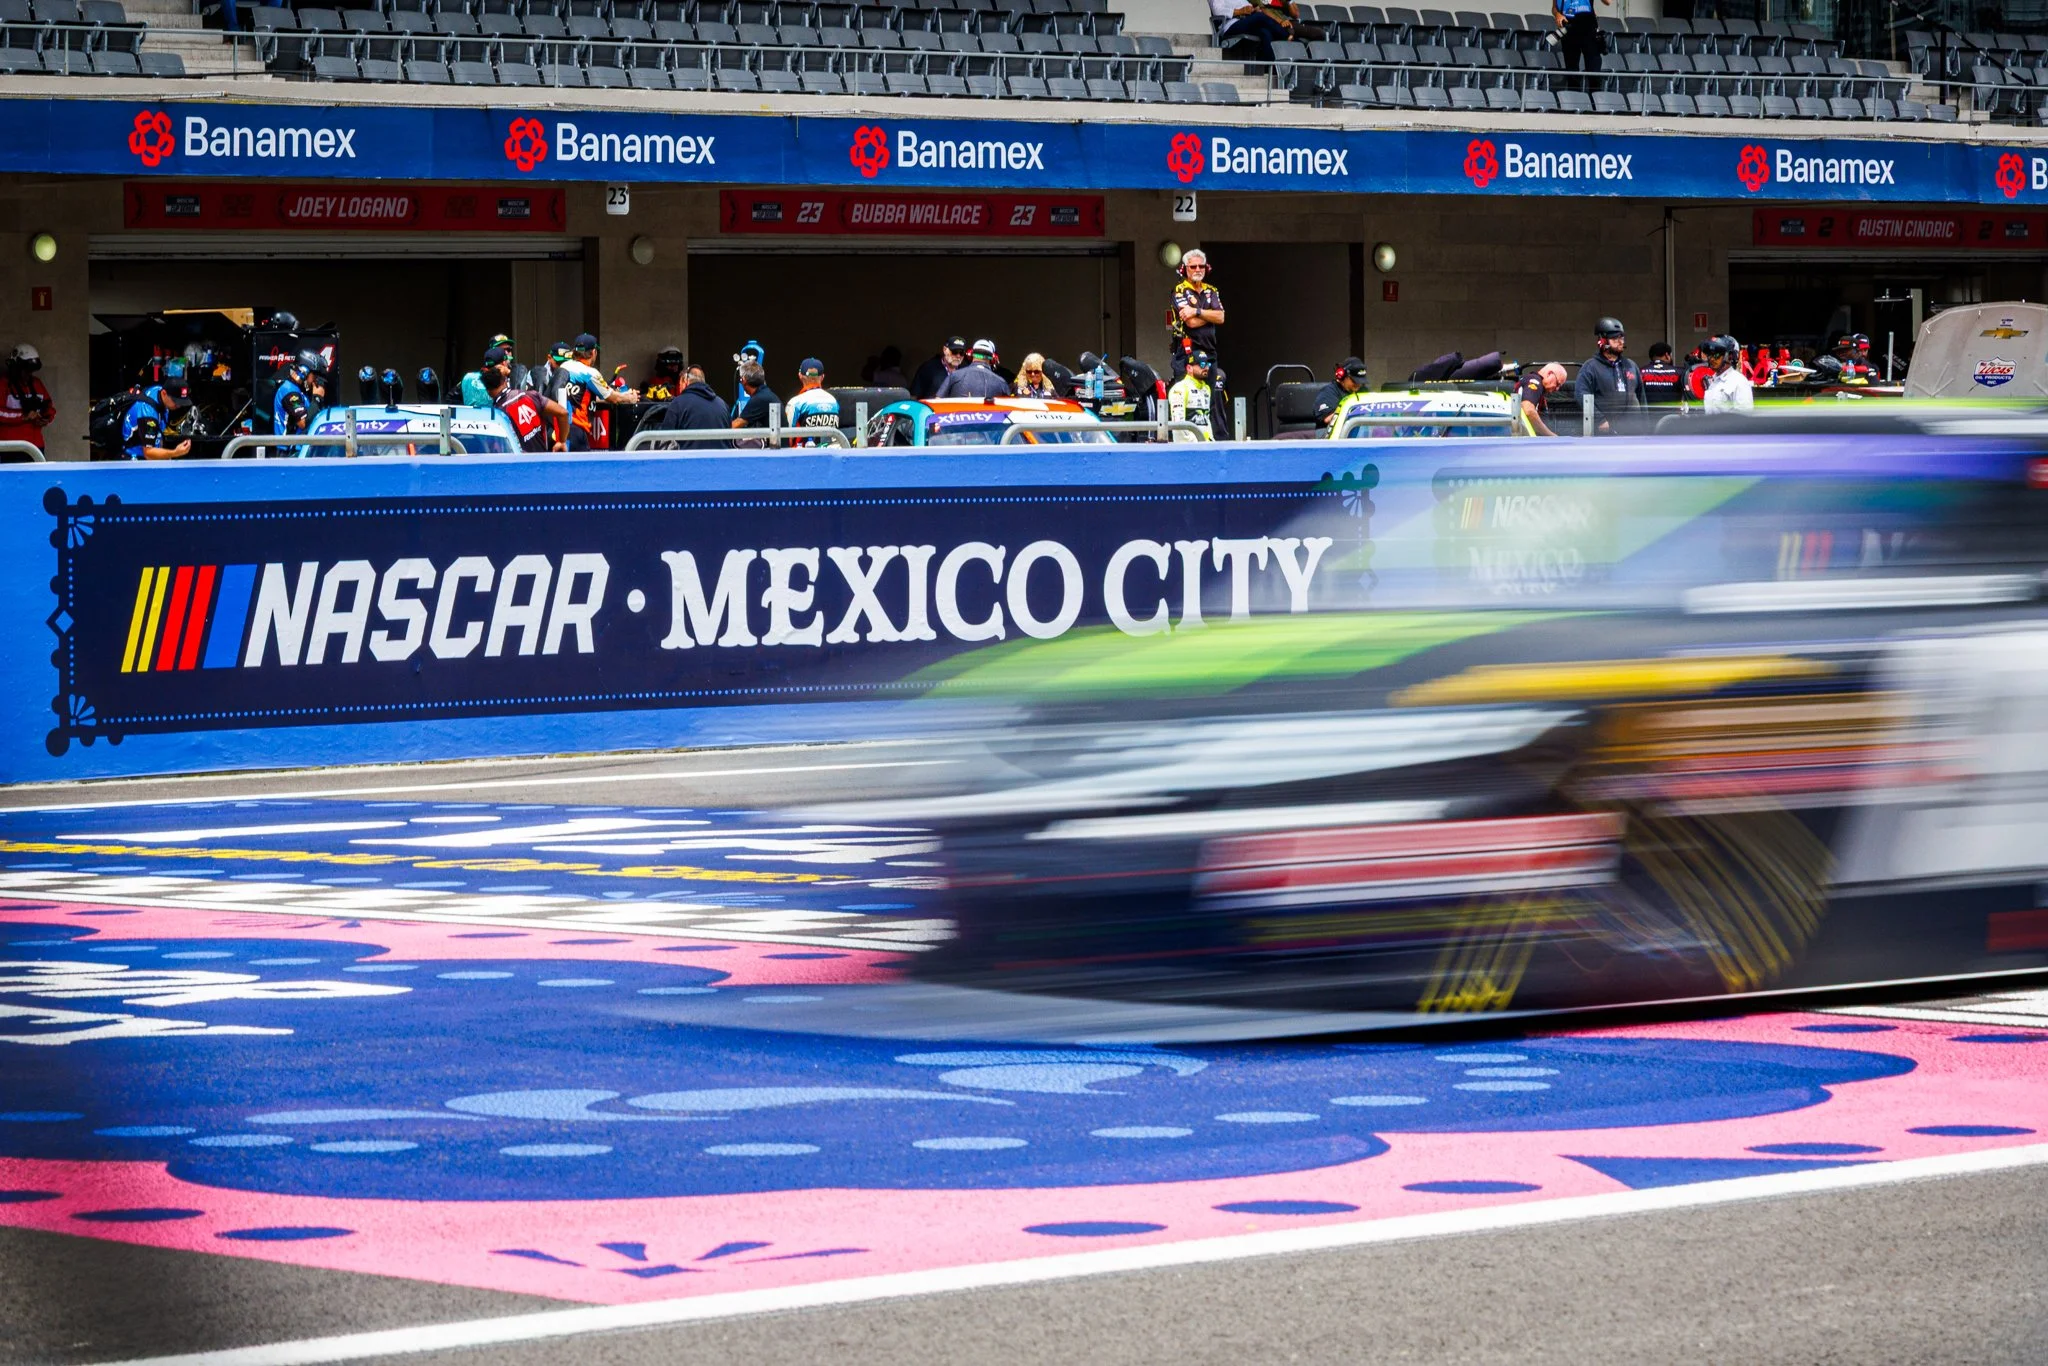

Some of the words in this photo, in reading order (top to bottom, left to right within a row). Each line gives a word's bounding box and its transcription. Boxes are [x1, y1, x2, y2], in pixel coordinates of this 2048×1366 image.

[185, 116, 356, 158] Banamex
[556, 122, 716, 165] Banamex
[897, 130, 1045, 171] Banamex
[1211, 137, 1349, 176] Banamex
[1505, 143, 1634, 180] Banamex
[1776, 149, 1896, 185] Banamex
[608, 187, 627, 205] 23
[1175, 196, 1194, 213] 22
[289, 197, 336, 218] JOEY
[338, 197, 408, 218] LOGANO
[797, 203, 825, 224] 23
[851, 203, 908, 224] BUBBA
[909, 204, 982, 225] WALLACE
[1009, 205, 1036, 226] 23
[1858, 219, 1903, 238] AUSTIN
[1904, 220, 1955, 238] CINDRIC
[1358, 401, 1414, 412] xfinity
[937, 411, 993, 424] xfinity
[243, 552, 611, 668] NASCAR
[661, 540, 1085, 650] MEXICO
[1103, 536, 1333, 637] CITY
